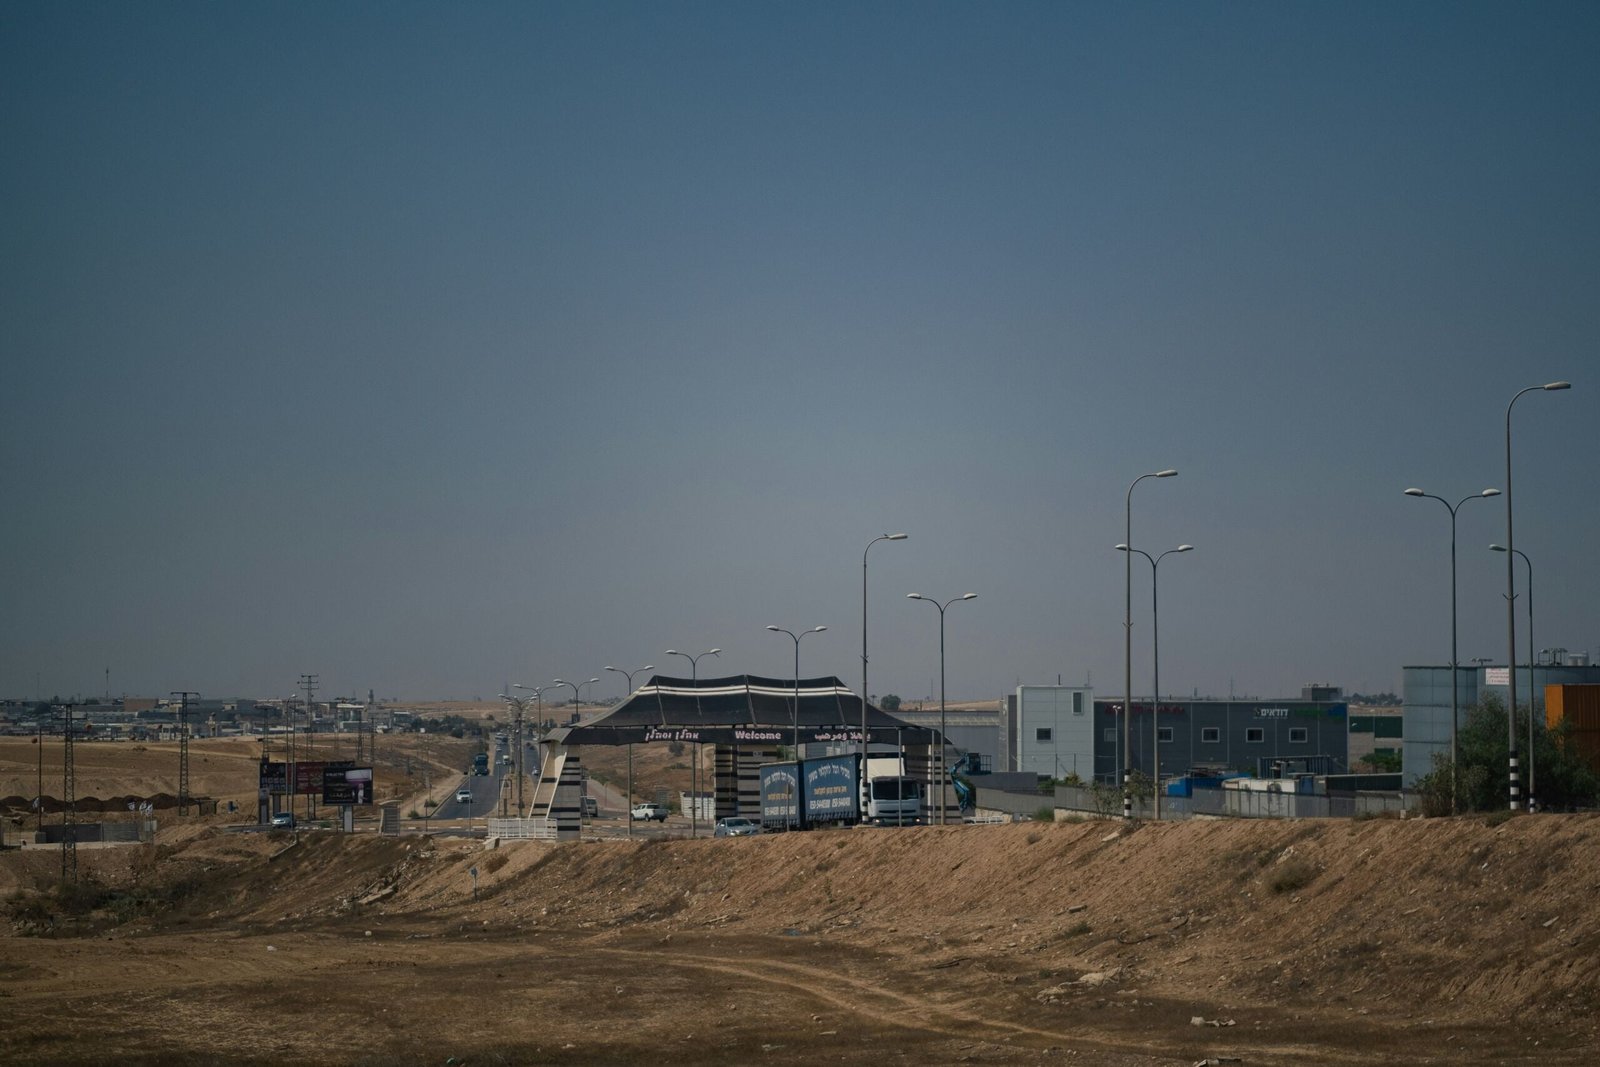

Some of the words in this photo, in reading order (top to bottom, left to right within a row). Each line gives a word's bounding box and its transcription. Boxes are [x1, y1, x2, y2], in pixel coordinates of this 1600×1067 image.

[645, 728, 672, 742] וסהלן
[675, 728, 699, 740] אהלן
[735, 730, 782, 740] Welcome
